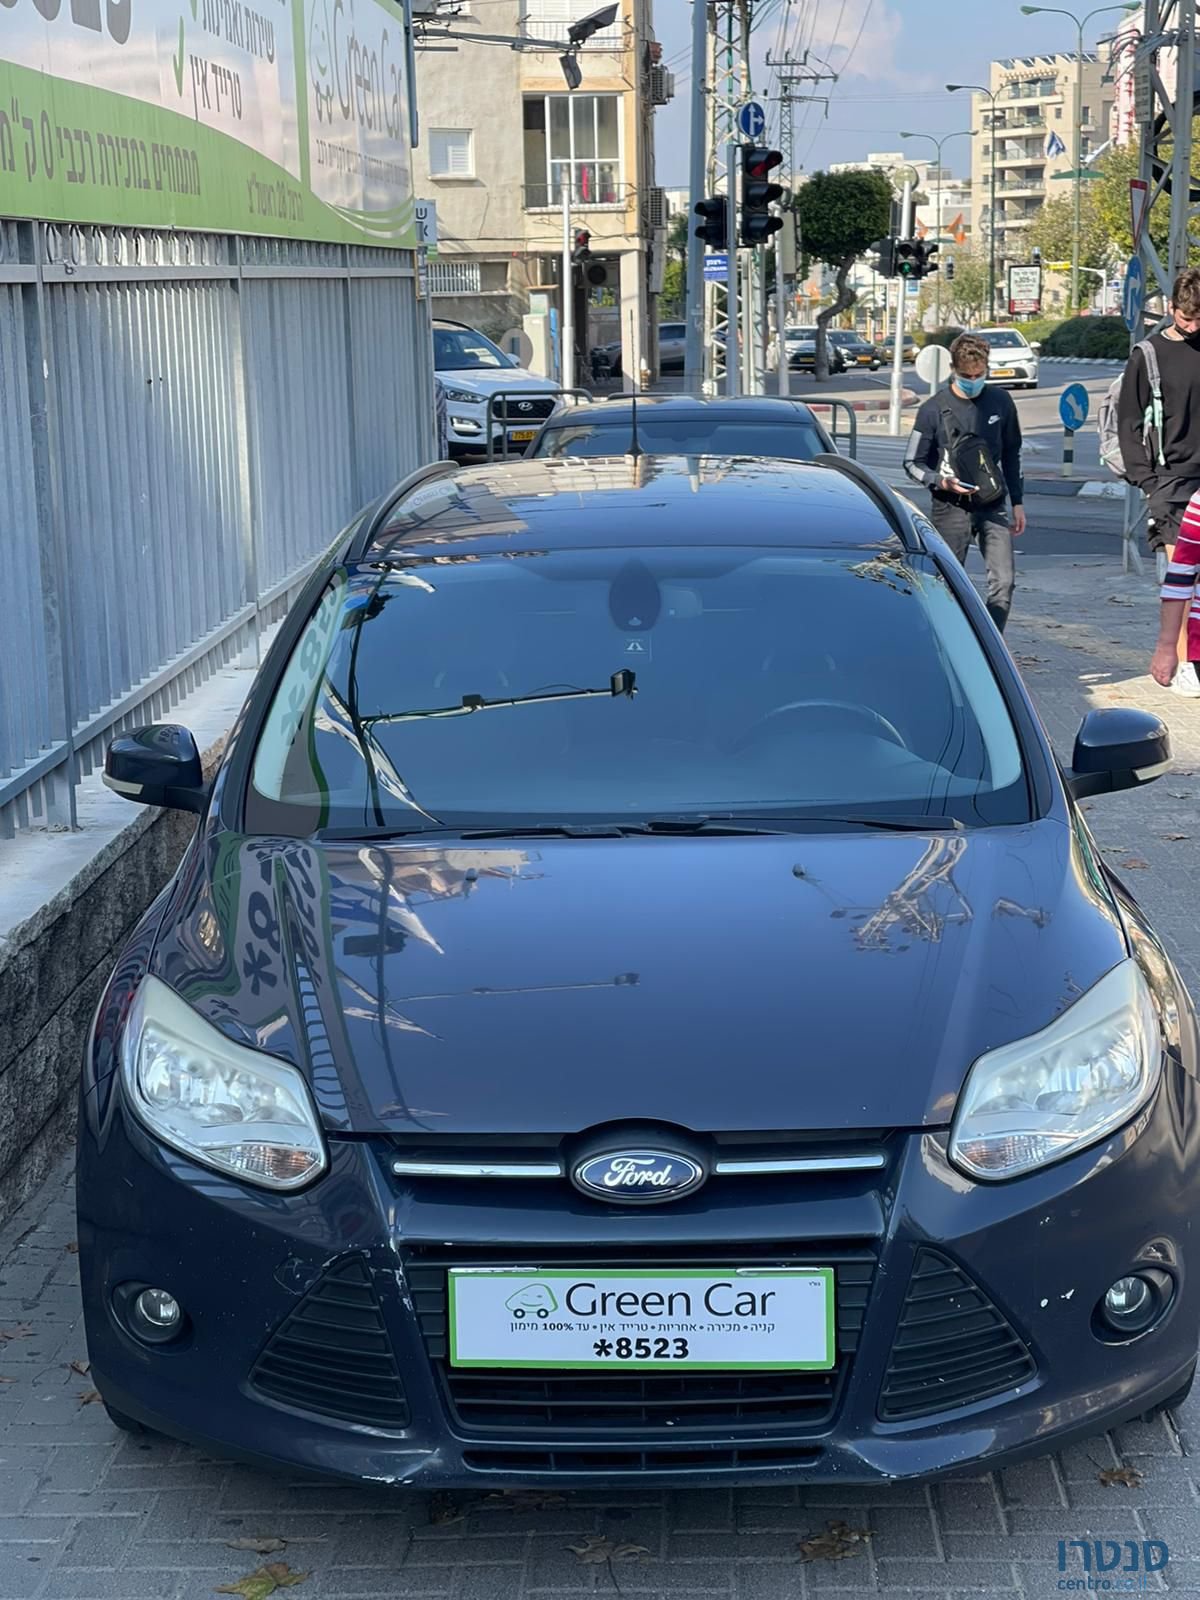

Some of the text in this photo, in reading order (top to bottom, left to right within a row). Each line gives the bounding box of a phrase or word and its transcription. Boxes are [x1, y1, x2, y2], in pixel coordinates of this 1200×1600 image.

[190, 54, 242, 121] טרייד אין
[334, 0, 403, 142] Green Car
[56, 126, 96, 184] רכבי
[151, 143, 201, 195] מתמחים
[604, 1158, 672, 1187] Ford
[565, 1282, 776, 1317] Green Car
[510, 1322, 775, 1334] קניה מכירה אחריות טרייד אין עד 100% מימון
